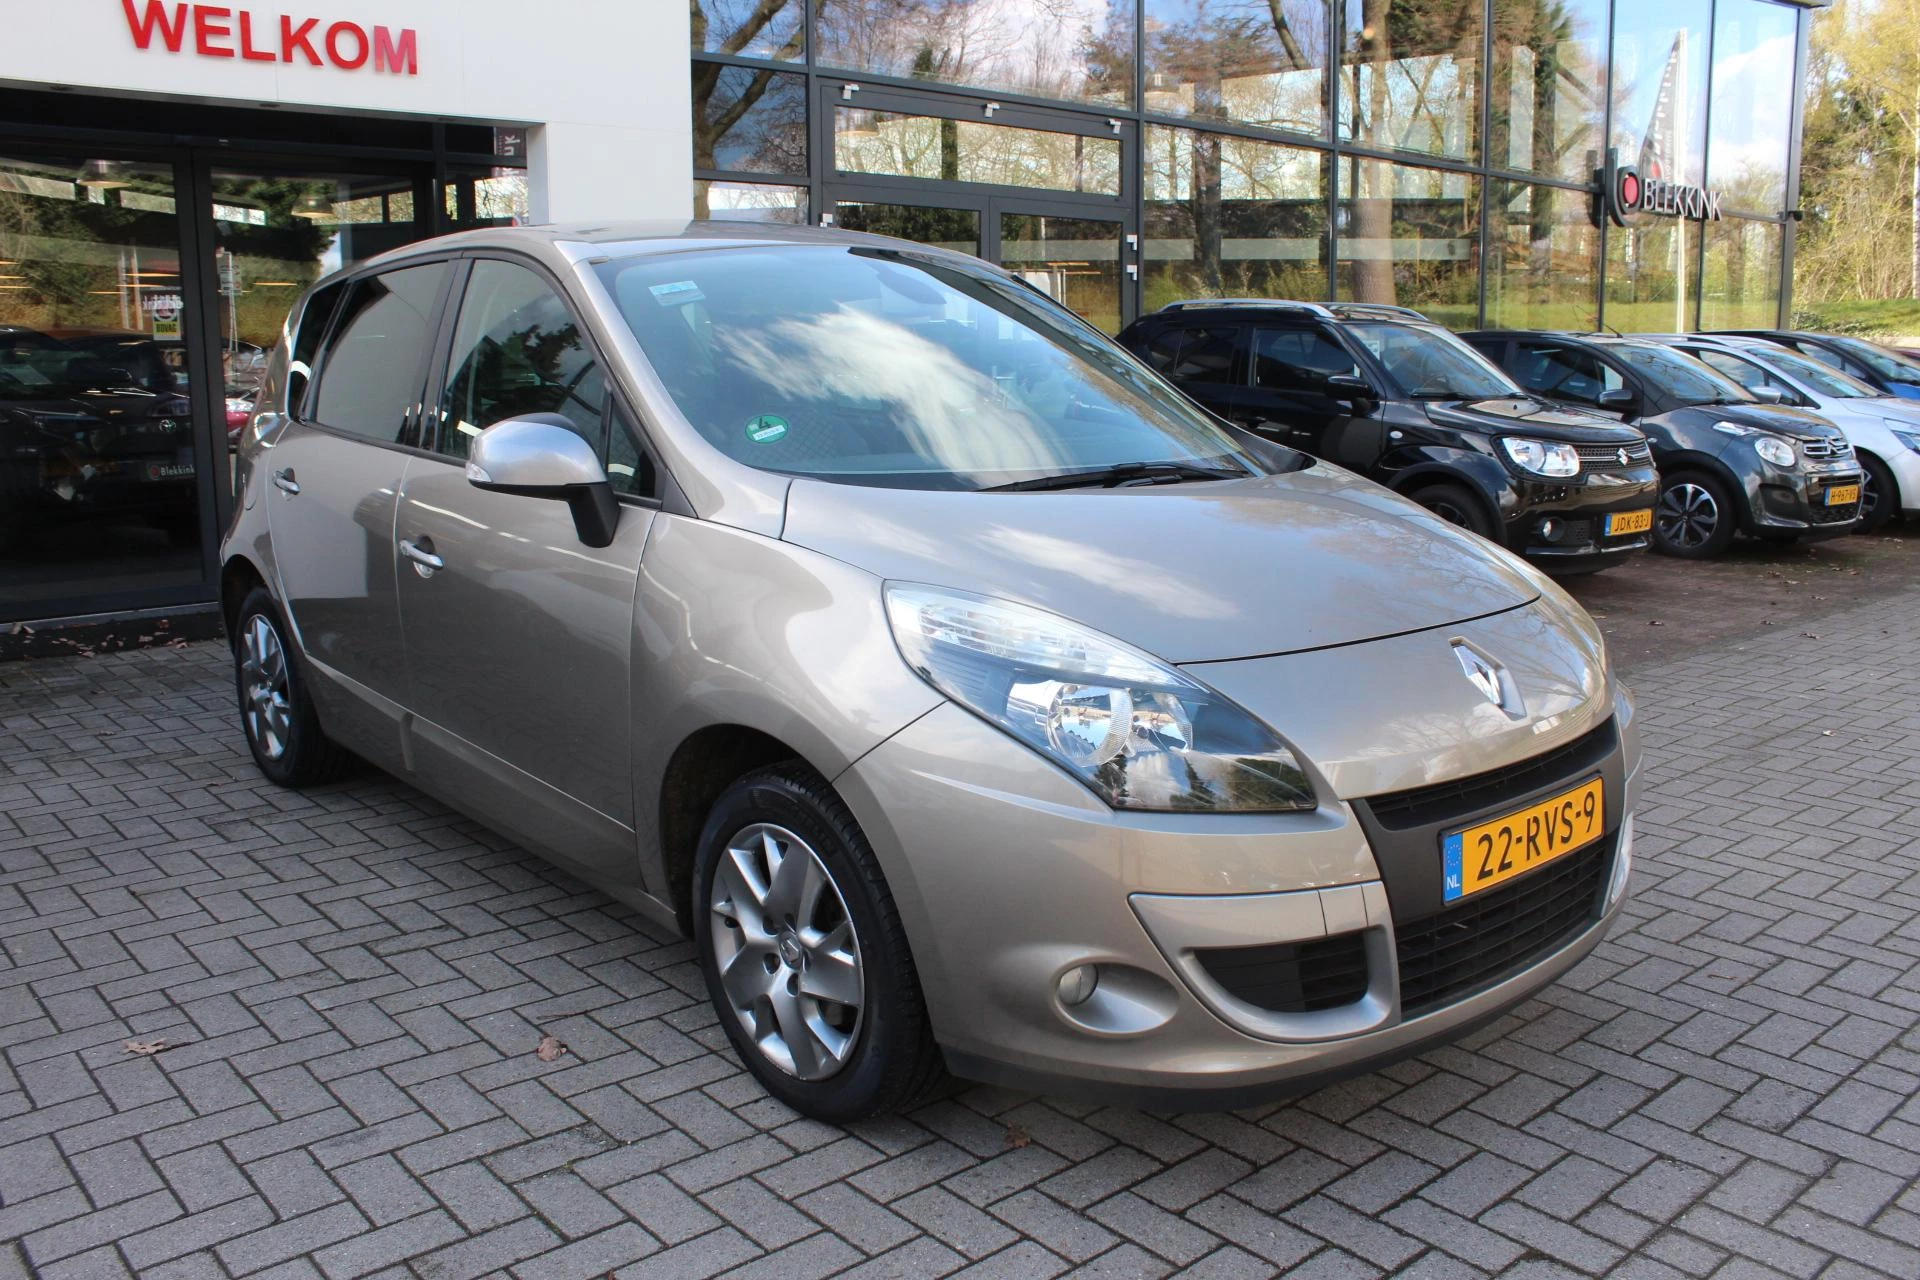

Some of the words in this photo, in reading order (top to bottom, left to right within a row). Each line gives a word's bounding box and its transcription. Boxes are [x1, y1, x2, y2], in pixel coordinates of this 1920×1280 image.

[121, 0, 418, 76] WELKOM
[1643, 177, 1723, 221] BLEKKINK
[1613, 513, 1650, 532] JDK-83-J
[1476, 790, 1596, 882] 22-RVS-9
[1446, 875, 1461, 891] NL
